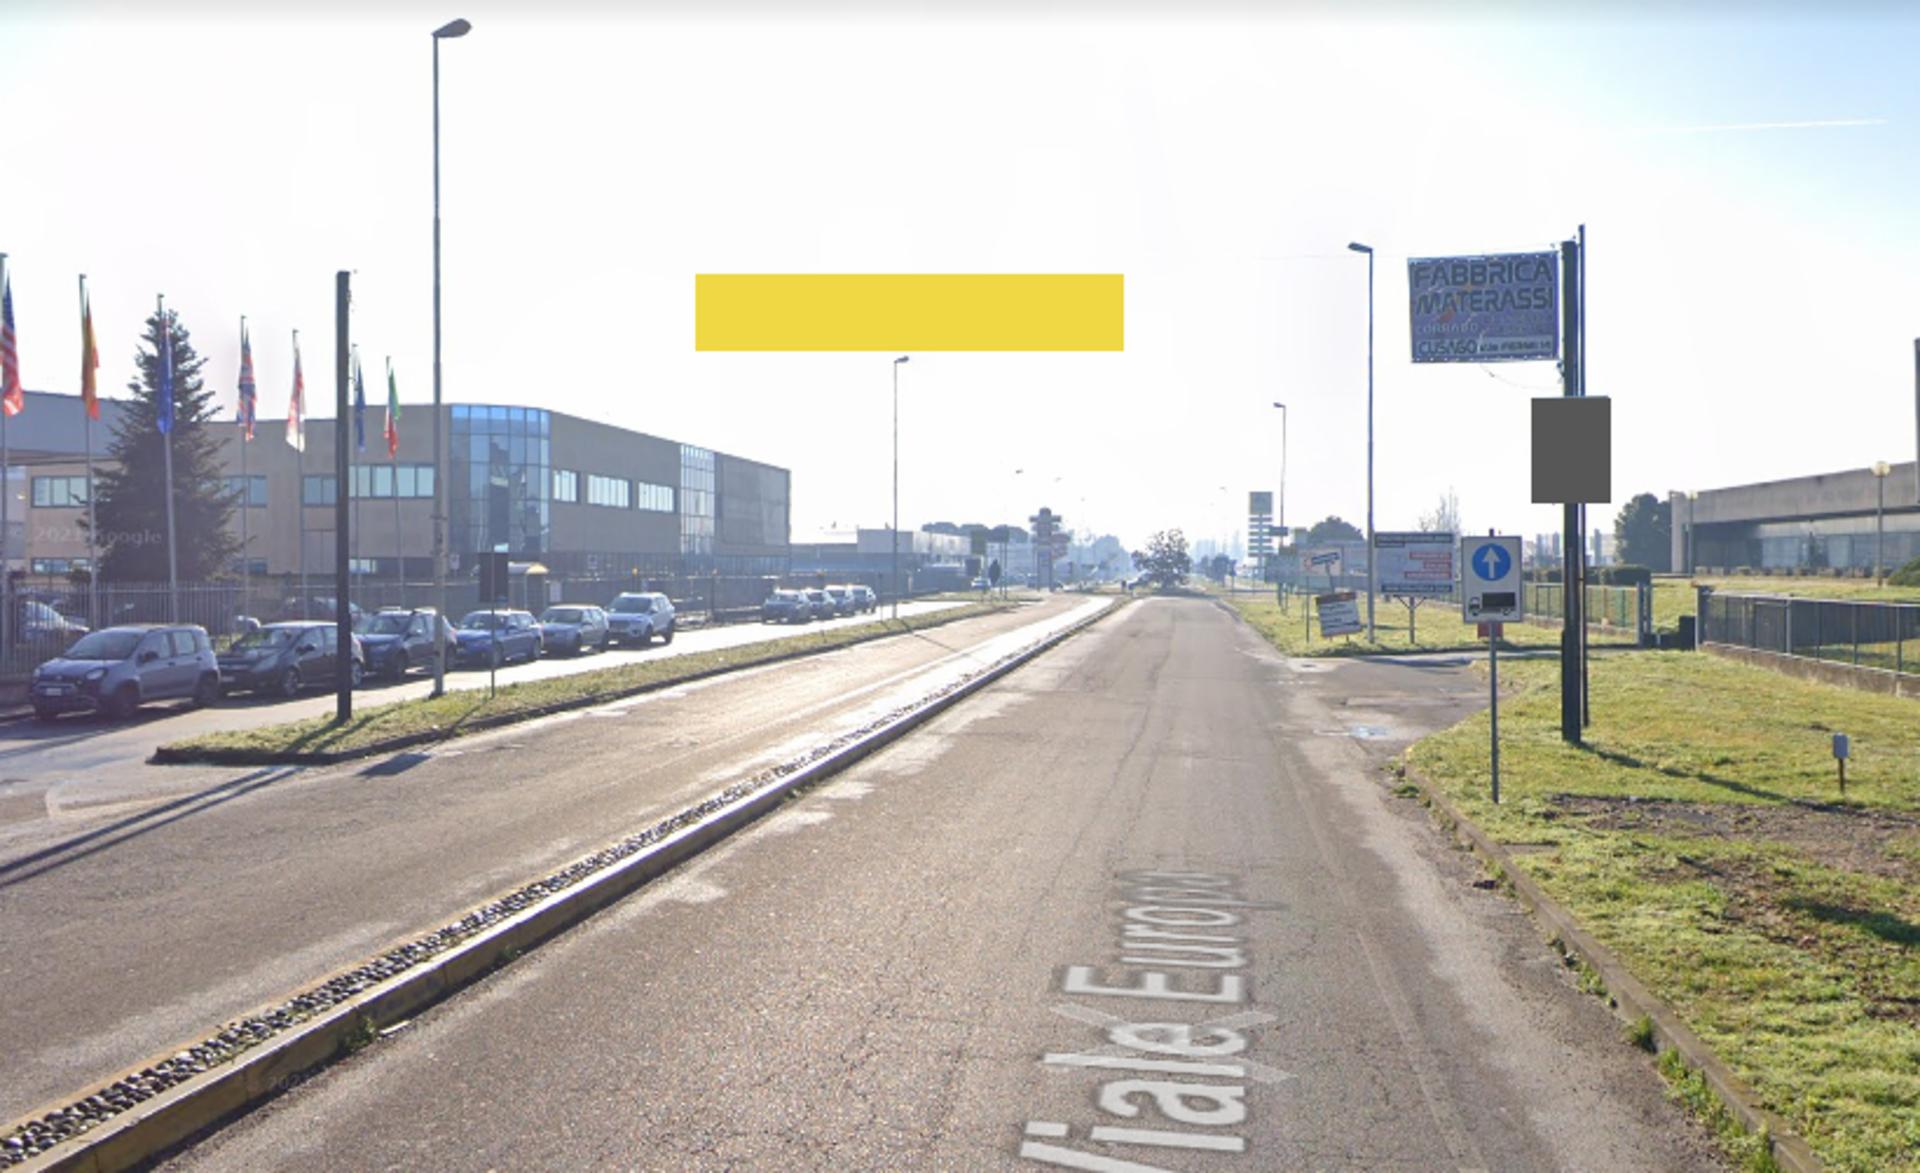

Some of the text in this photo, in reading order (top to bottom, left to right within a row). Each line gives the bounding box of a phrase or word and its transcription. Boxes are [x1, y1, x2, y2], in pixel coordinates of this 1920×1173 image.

[1415, 259, 1553, 288] FABBRICA
[1415, 287, 1553, 315] MATERASSI
[1418, 339, 1477, 354] CUSAGO
